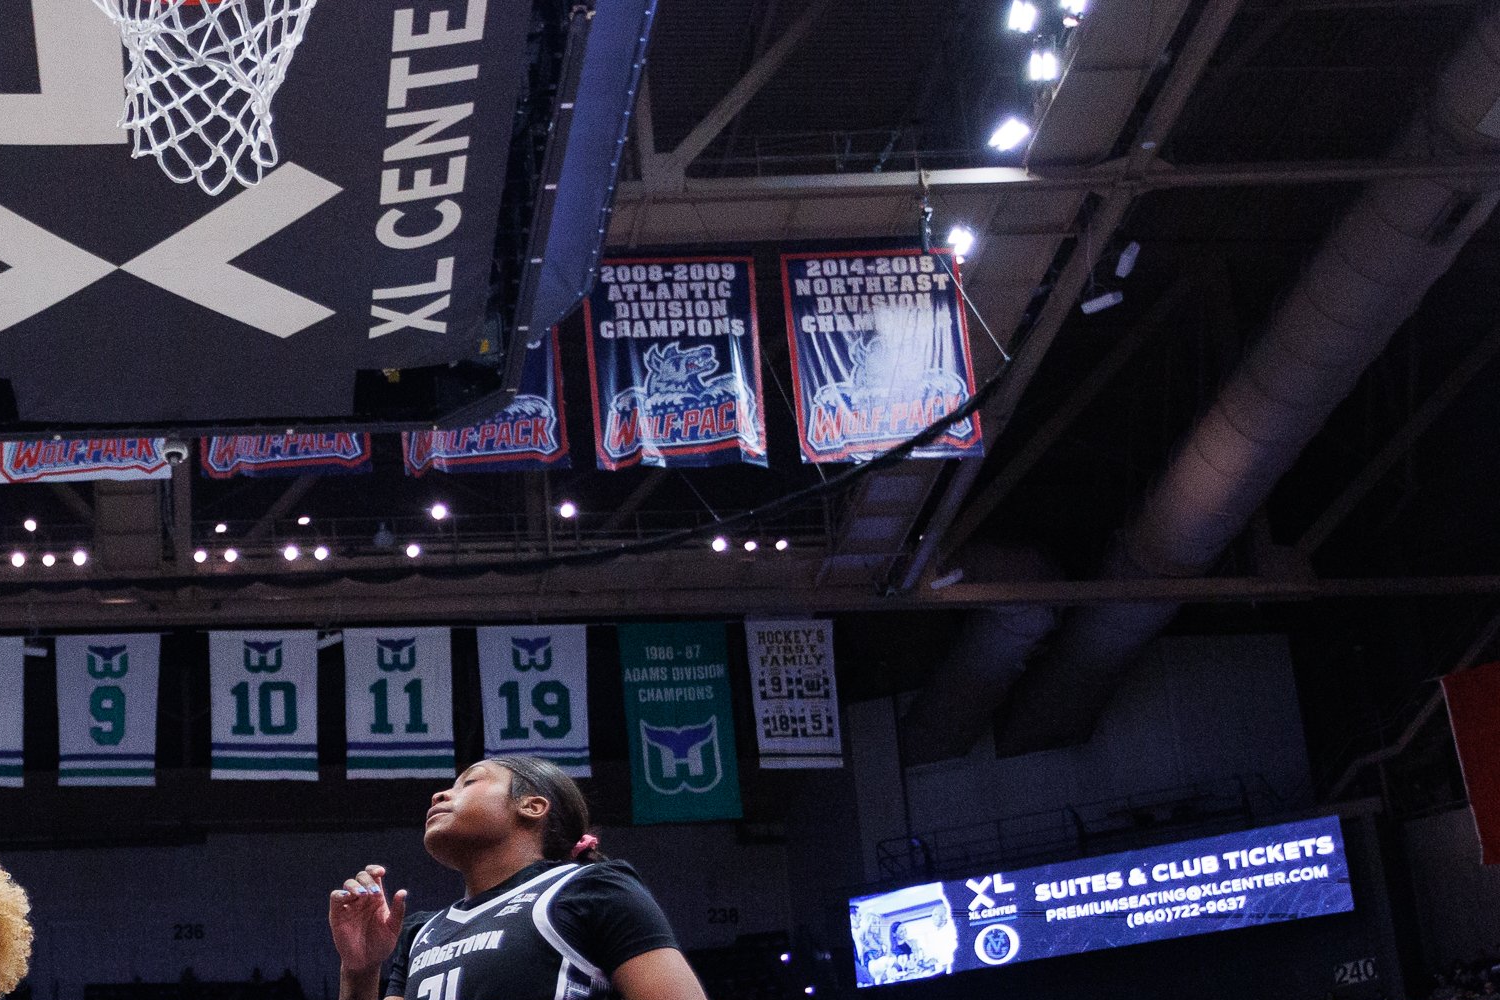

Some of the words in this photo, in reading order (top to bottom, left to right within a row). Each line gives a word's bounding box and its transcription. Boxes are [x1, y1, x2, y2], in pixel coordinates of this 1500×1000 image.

[601, 263, 736, 283] 2008-2009
[806, 255, 935, 277] 2014-2015
[608, 281, 731, 301] ATLANTIC
[795, 273, 949, 296] NORTHEAST
[368, 256, 455, 339] XL
[615, 299, 728, 319] DIVISION
[816, 292, 932, 314] DIVISION
[600, 317, 746, 338] CHAMPIONS
[760, 654, 824, 667] FAMILY
[624, 666, 669, 682] ADAMS
[672, 663, 725, 681] DIVISION
[638, 685, 715, 703] CHAMPIONS
[88, 685, 127, 746] 9
[230, 681, 298, 735] 10
[368, 678, 429, 734] 11
[498, 680, 572, 740] 19
[1035, 871, 1124, 902] SUITES
[1128, 867, 1147, 886] &
[1152, 855, 1219, 882] CLUB
[1223, 836, 1335, 870] TICKETS
[965, 872, 1015, 911] XL
[1045, 864, 1328, 922] PREMIUMSEATING@XLCENTER.COM
[981, 904, 1017, 919] CENTER
[1126, 895, 1246, 928] (860)722-9637
[173, 924, 204, 940] 236
[408, 930, 505, 978] GEORGETOWN
[1335, 958, 1376, 985] 240
